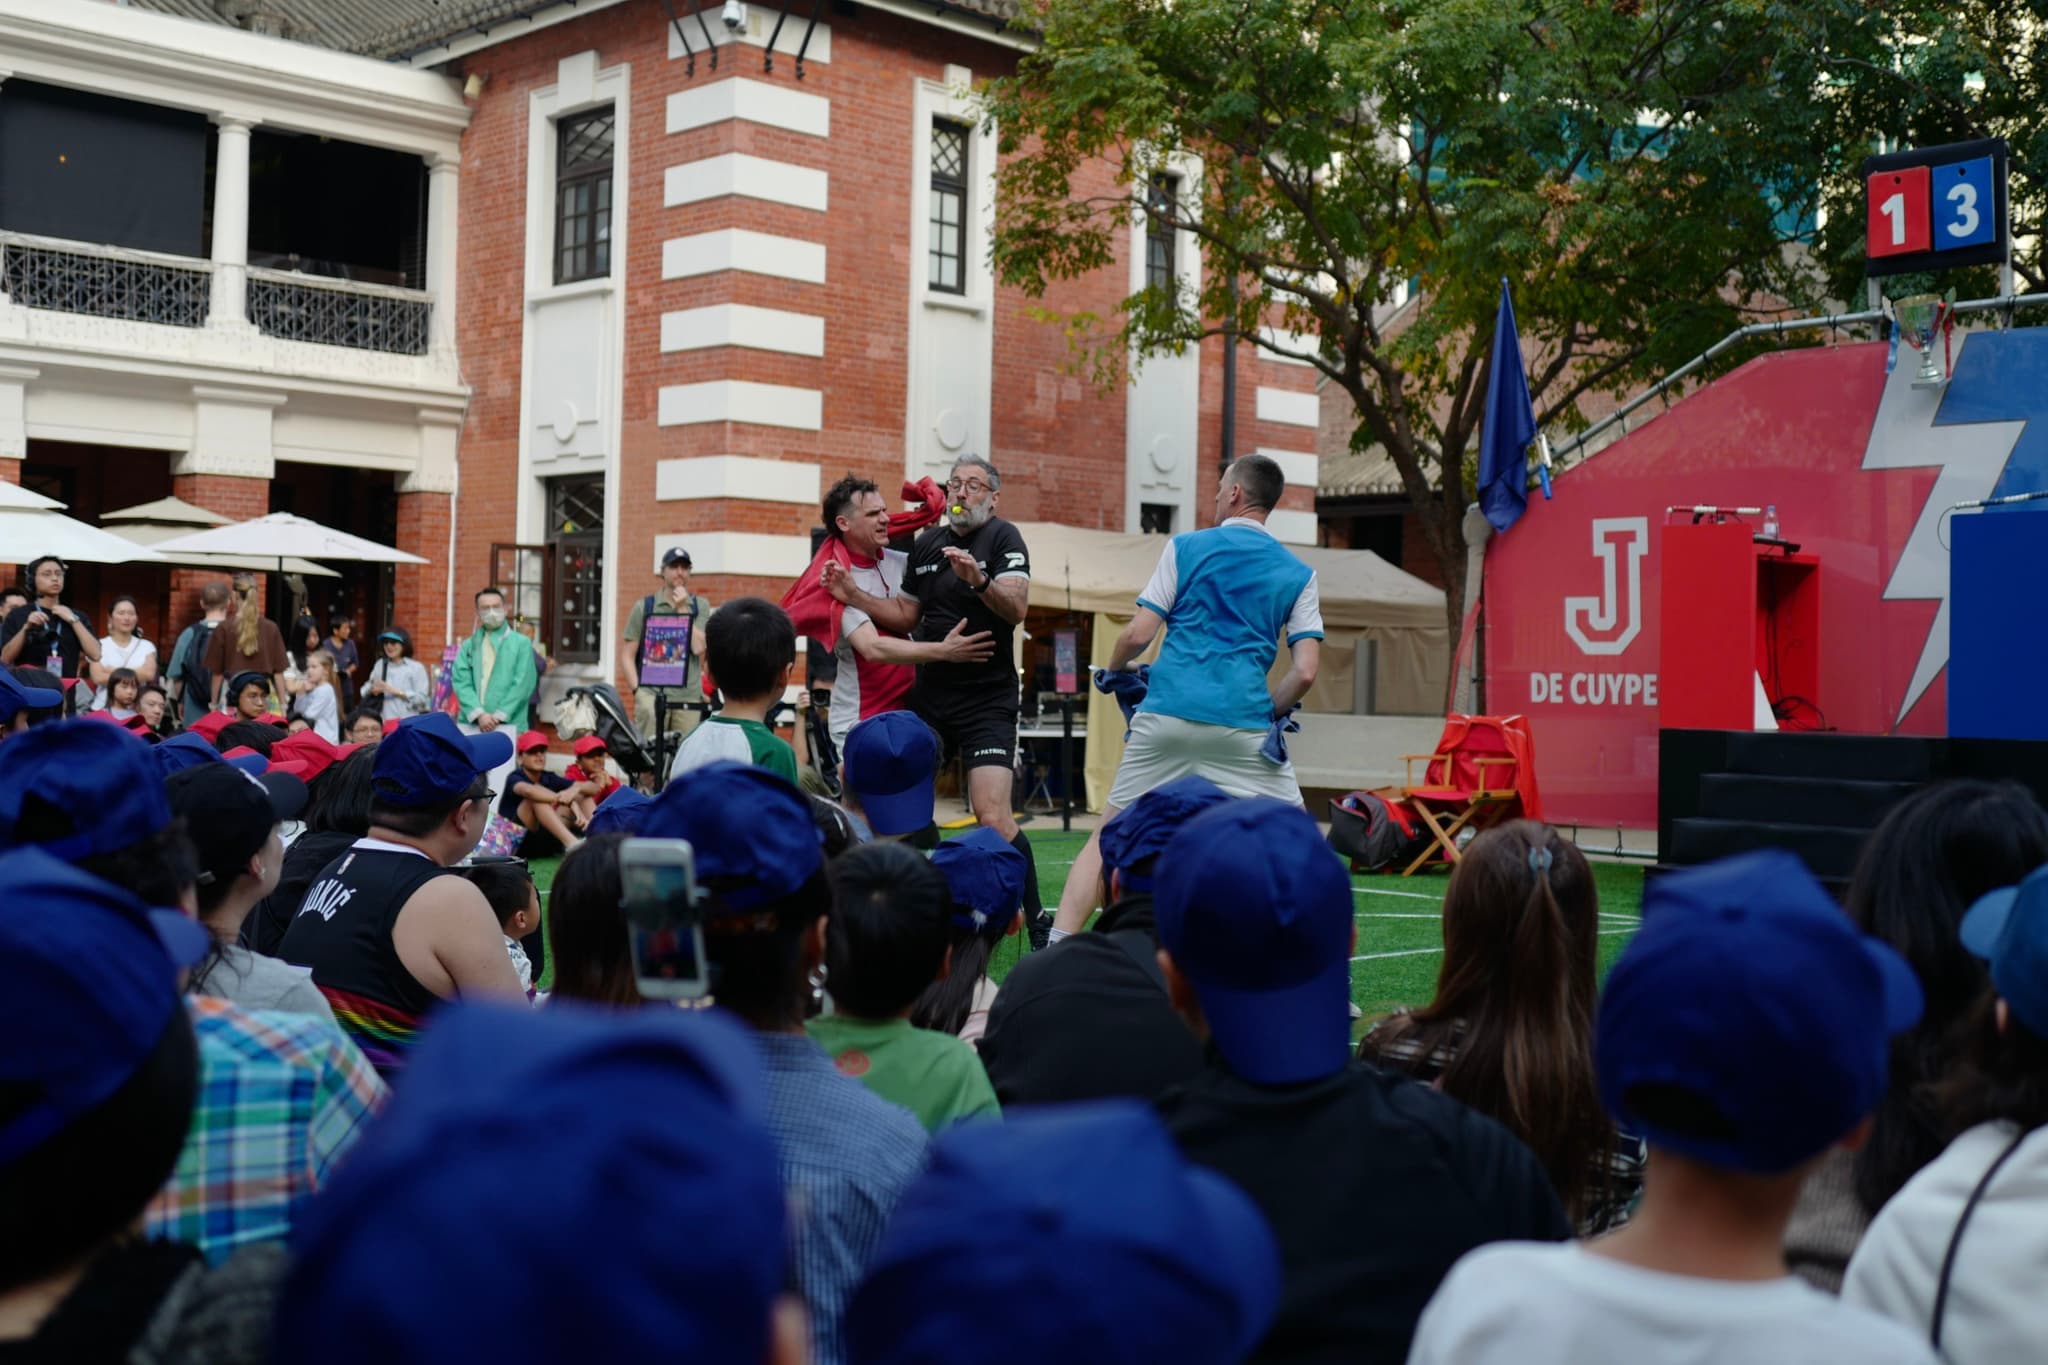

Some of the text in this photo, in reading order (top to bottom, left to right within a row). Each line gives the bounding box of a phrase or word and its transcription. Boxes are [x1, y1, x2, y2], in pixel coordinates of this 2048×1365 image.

[1880, 183, 1980, 246] 1 3
[1565, 516, 1649, 655] J
[1531, 672, 1563, 703] DE
